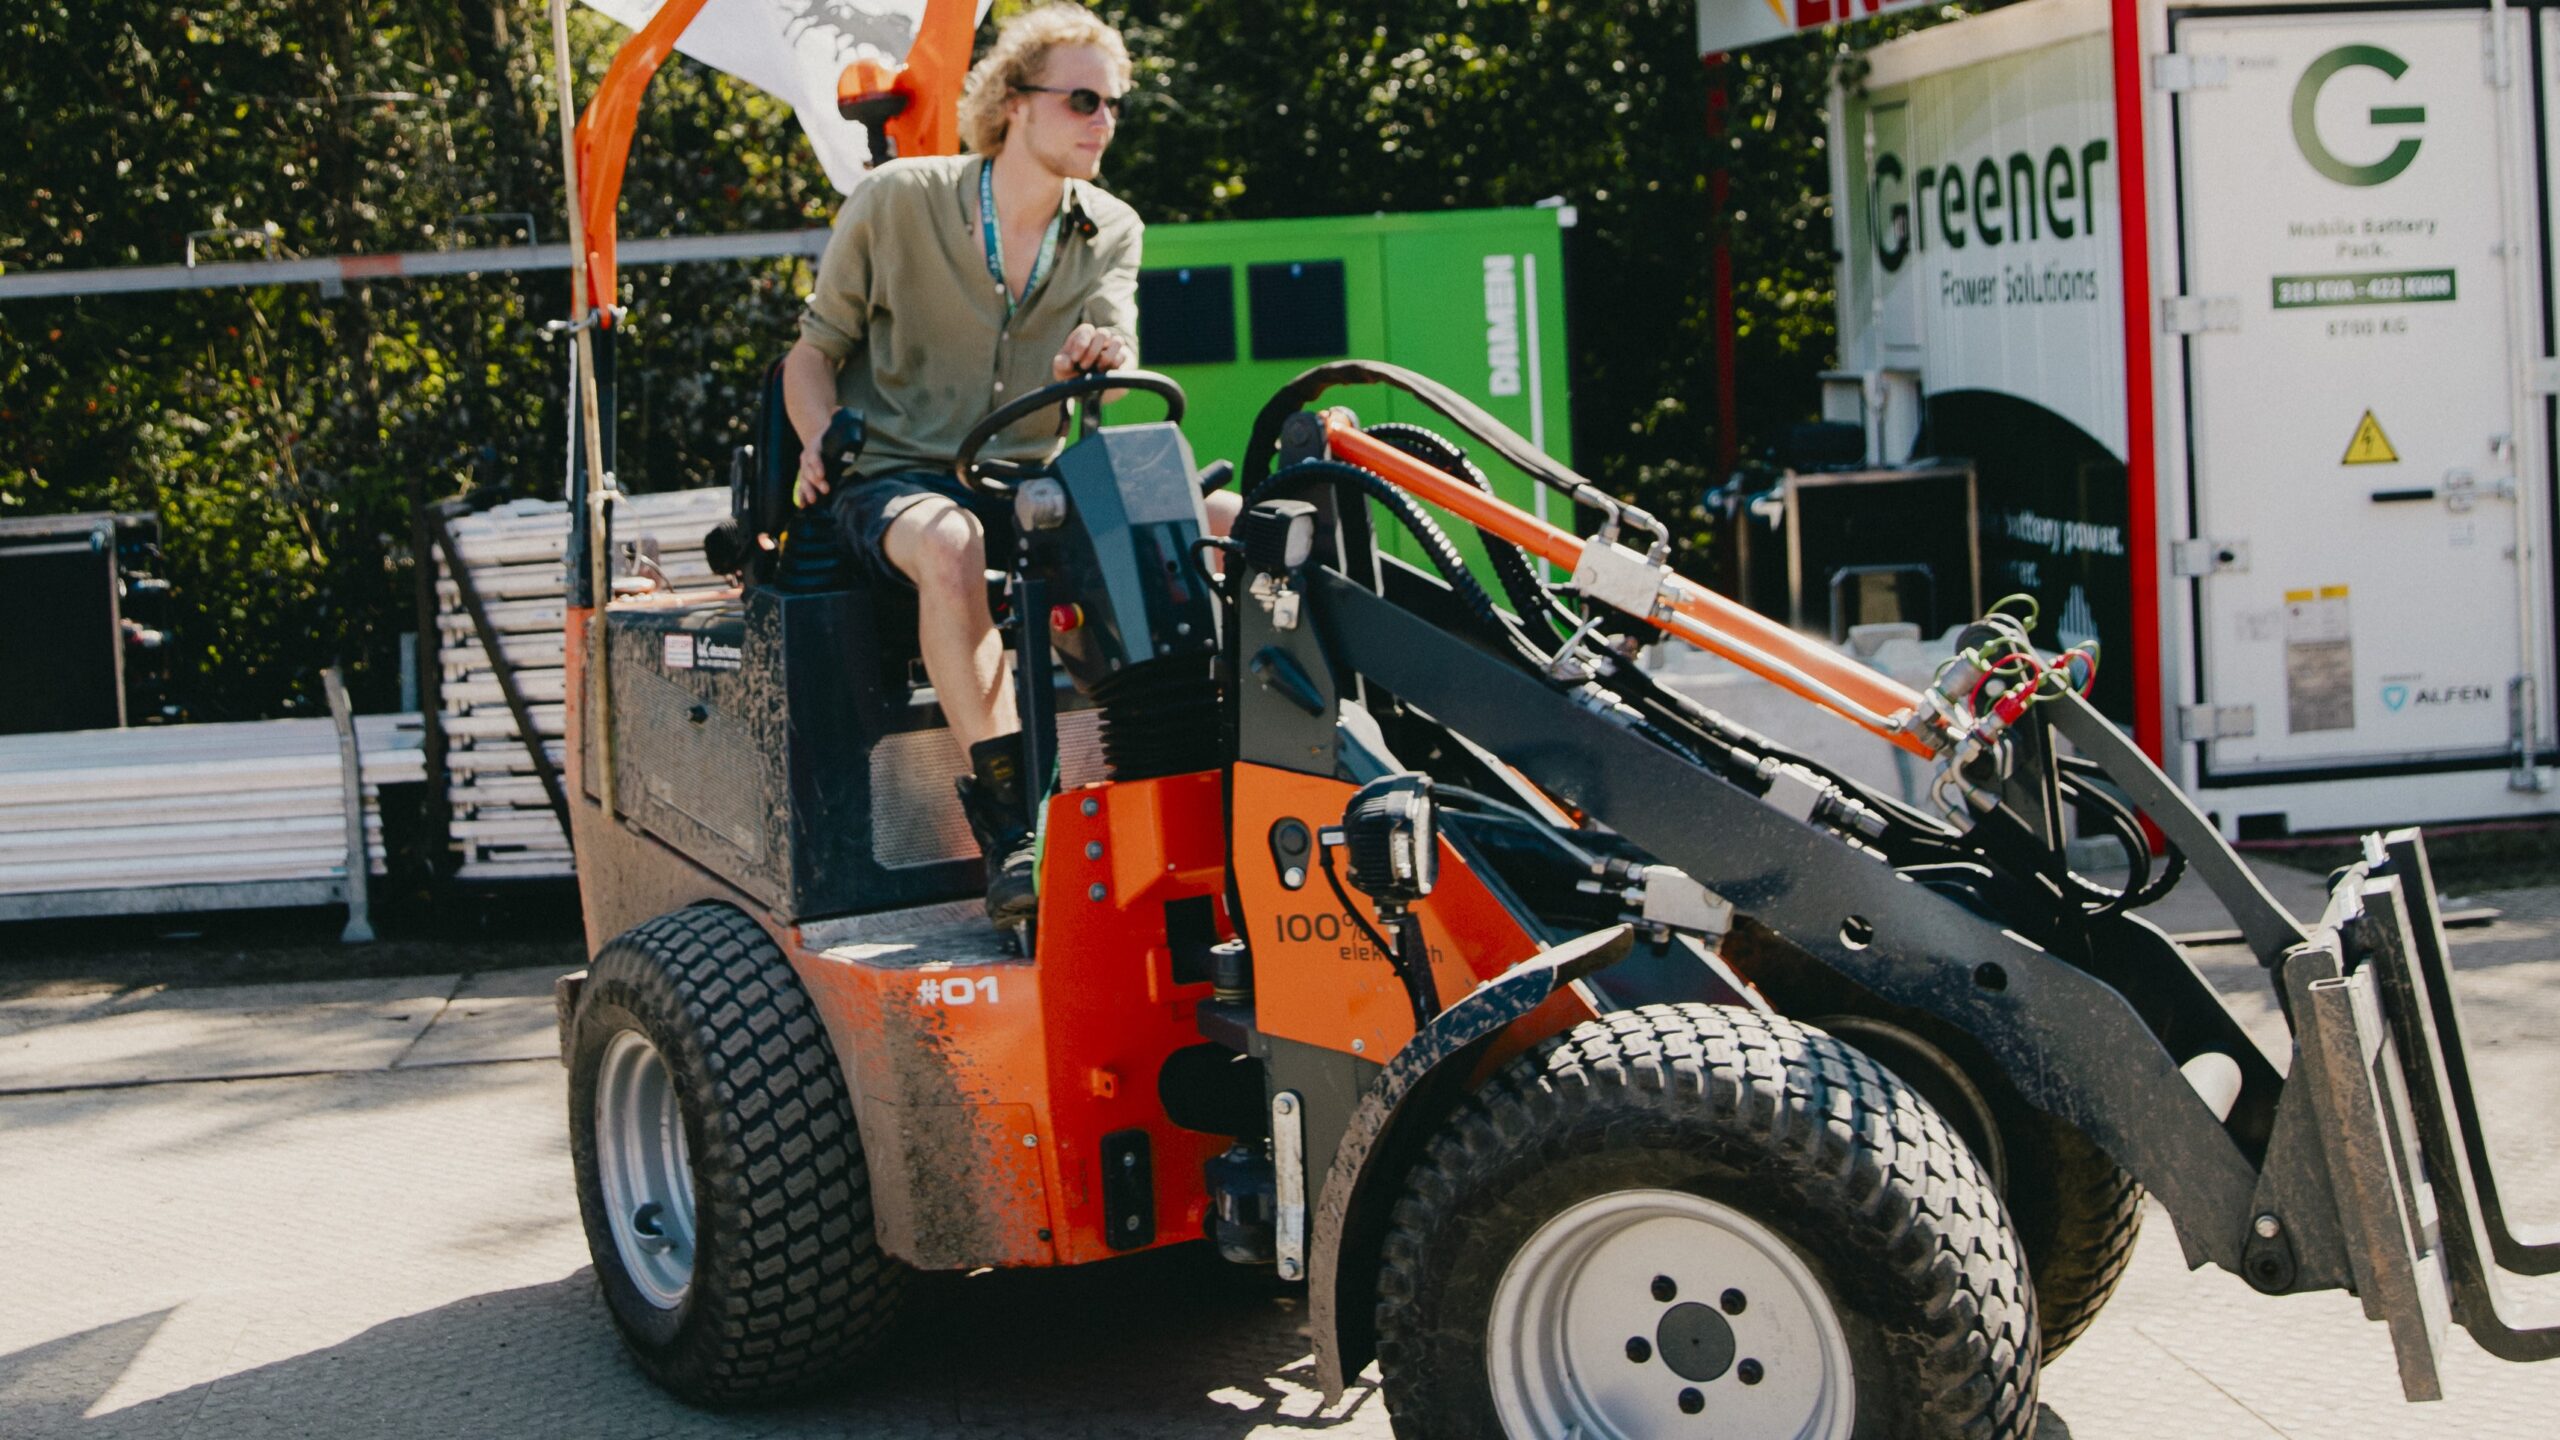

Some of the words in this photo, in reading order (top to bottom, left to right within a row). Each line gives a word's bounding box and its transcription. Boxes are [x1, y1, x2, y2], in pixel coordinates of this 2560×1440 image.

[1867, 139, 2108, 273] Greener
[2288, 221, 2354, 238] Mobile
[2364, 218, 2438, 236] Battery
[1942, 270, 1996, 307] Power
[2005, 261, 2098, 304] Solutions
[2316, 279, 2355, 301] KVA
[1484, 254, 1521, 397] DAMEN
[2380, 317, 2408, 335] KG
[2413, 683, 2491, 706] ALFEN
[1276, 911, 1374, 943] 100%
[917, 975, 1000, 1006] #01
